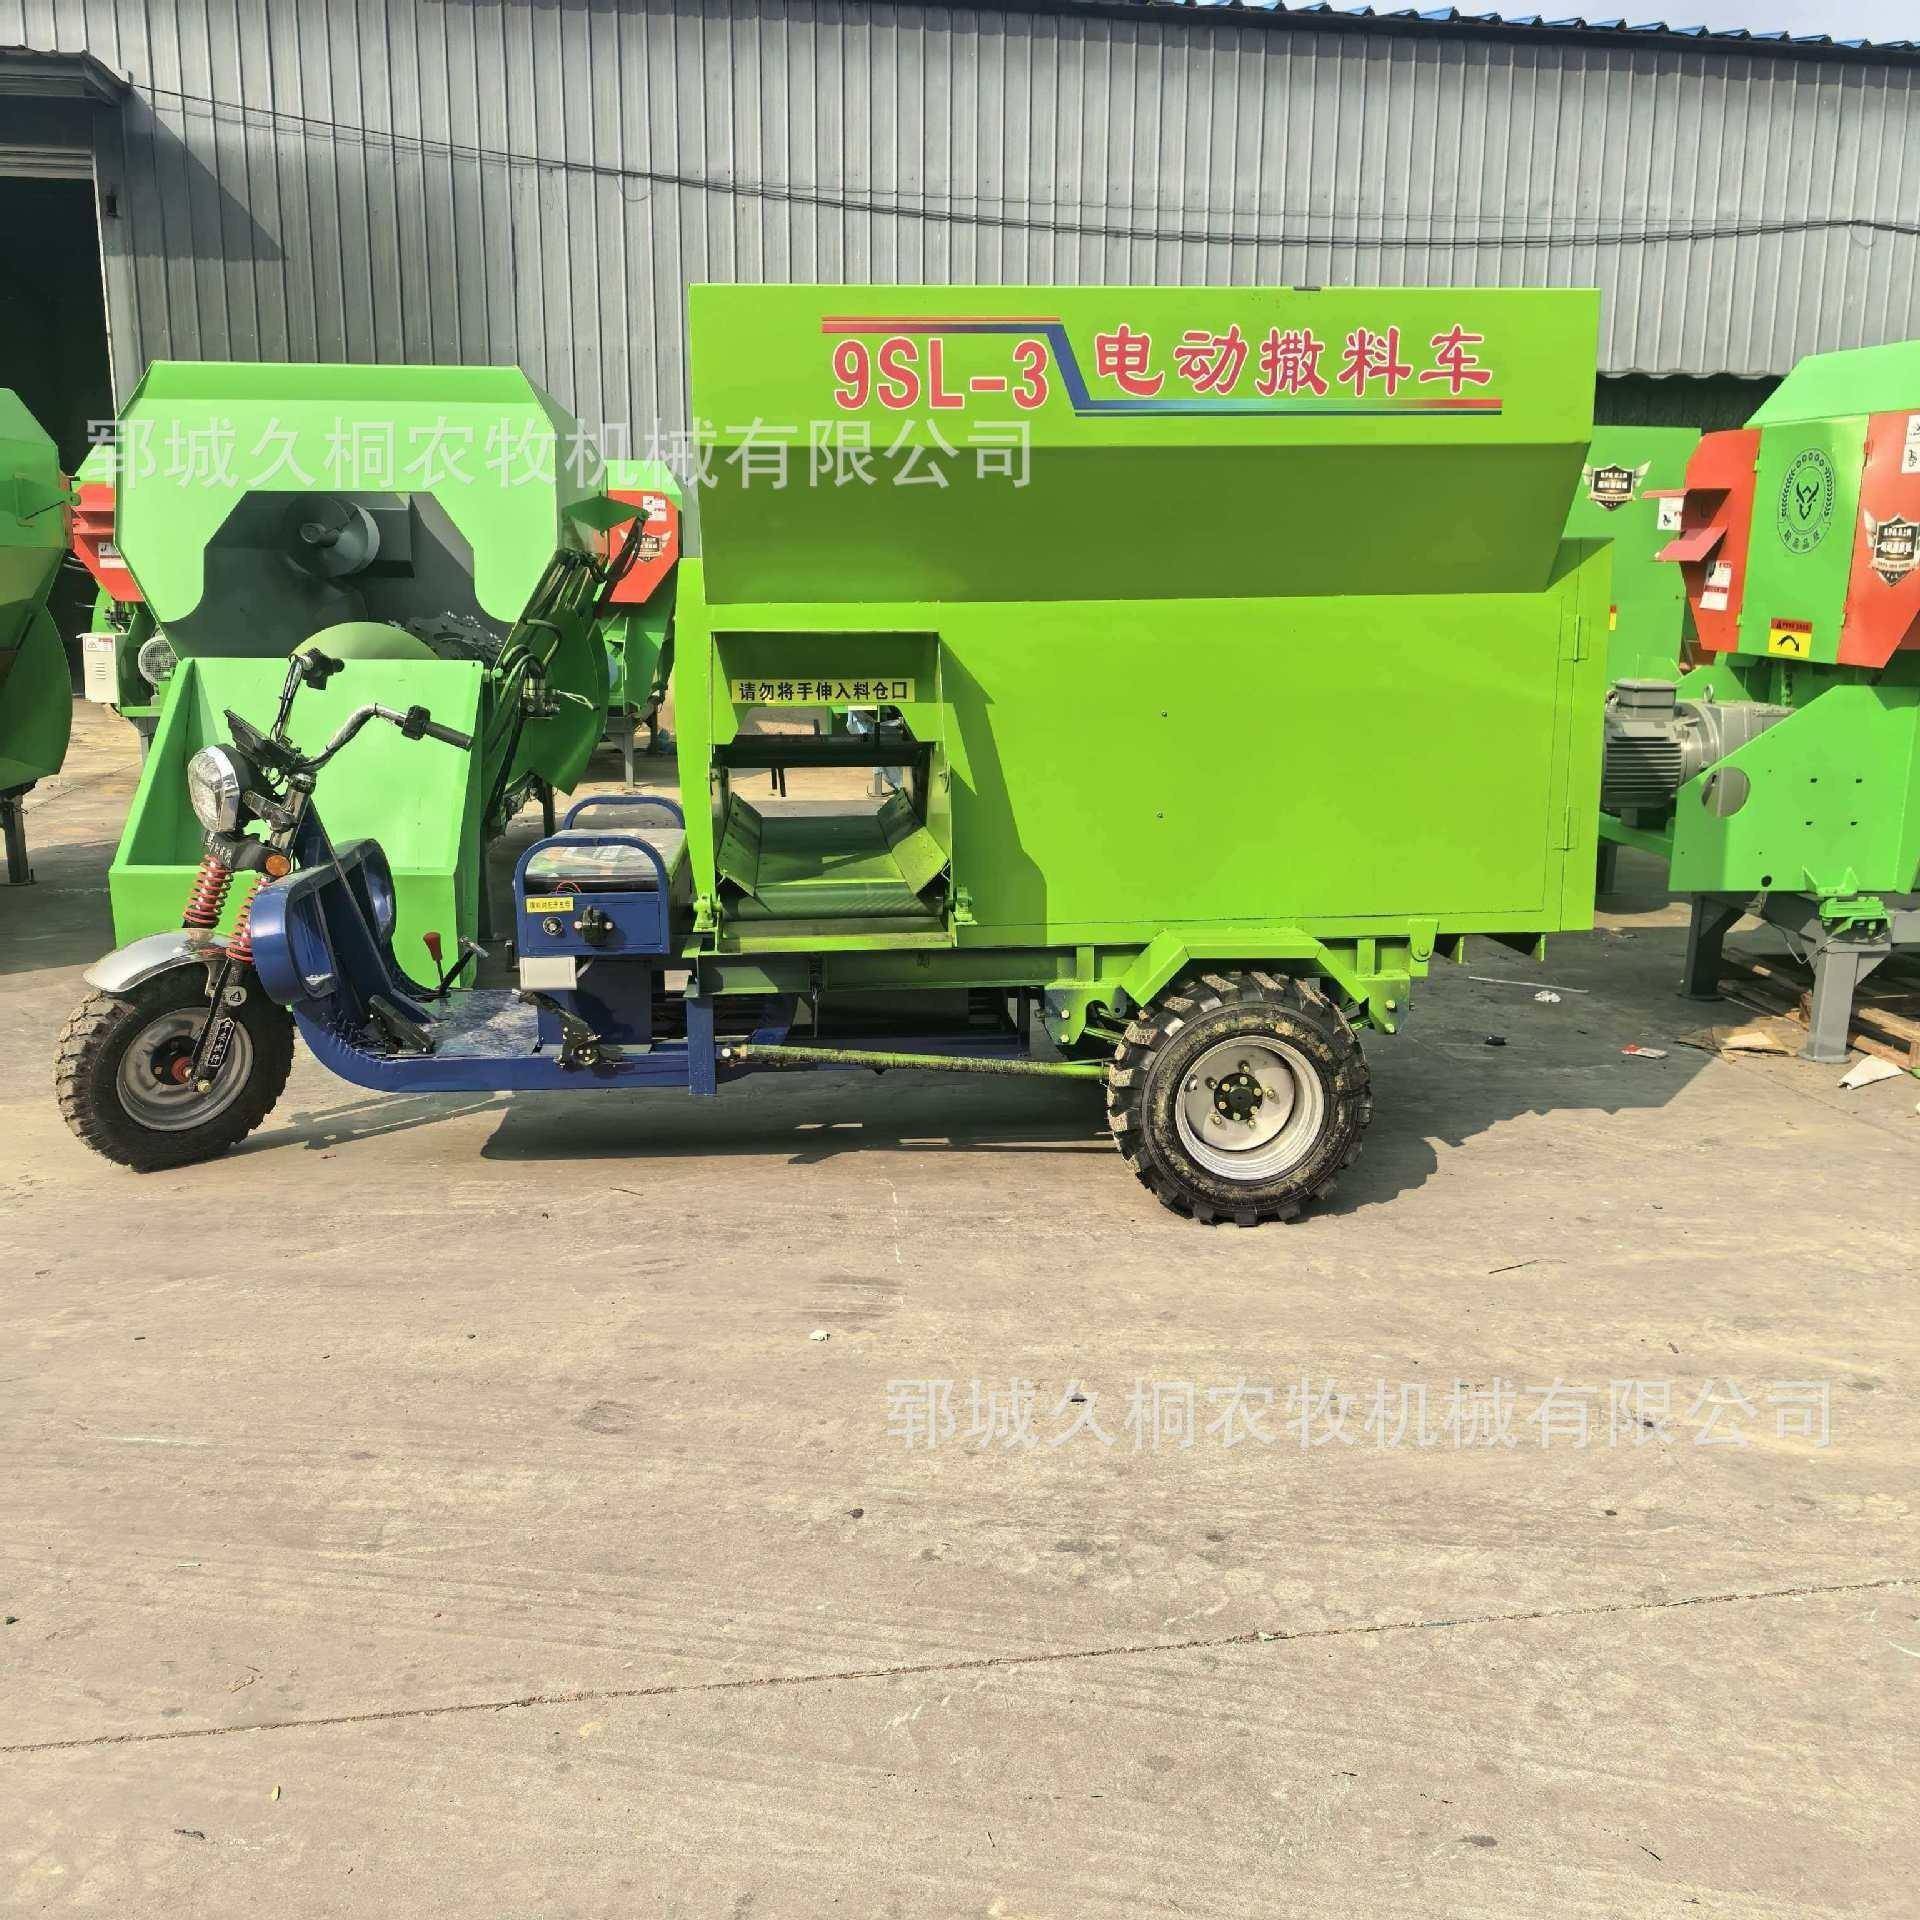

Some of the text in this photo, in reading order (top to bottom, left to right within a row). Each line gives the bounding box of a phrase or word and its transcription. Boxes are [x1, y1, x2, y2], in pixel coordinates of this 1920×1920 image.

[833, 324, 1492, 410] 9SL-3 电动撒料车
[739, 681, 908, 701] 请勿将手伸入料仓口
